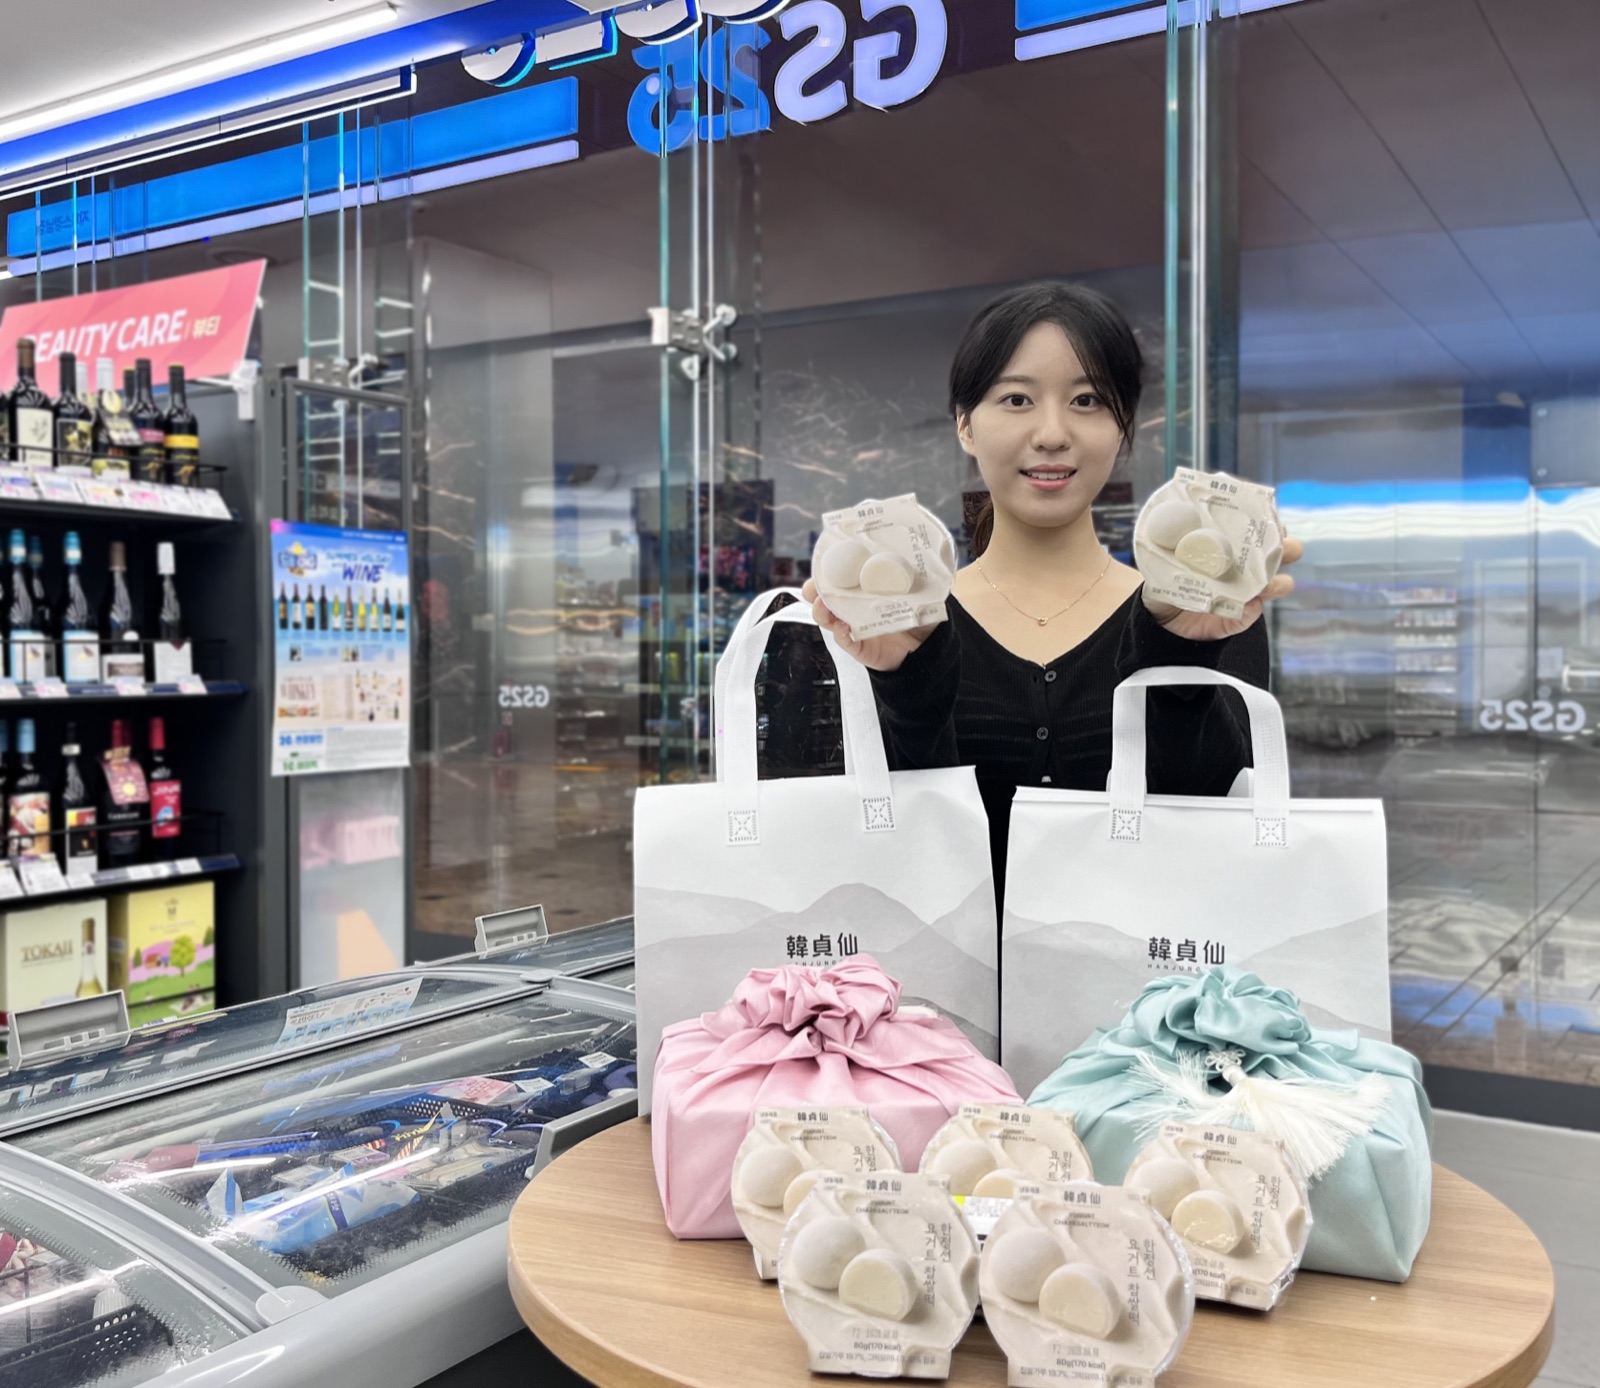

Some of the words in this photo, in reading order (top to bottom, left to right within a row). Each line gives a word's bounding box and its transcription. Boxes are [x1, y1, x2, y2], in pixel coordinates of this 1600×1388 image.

[23, 321, 118, 364] EAUTY
[117, 309, 187, 350] CARE
[193, 315, 221, 338] 뷰티
[343, 563, 385, 583] WINE
[786, 932, 858, 959] 韓貞仙
[1148, 936, 1225, 965] 韓貞仙
[924, 1224, 938, 1261] 요거트
[1127, 1240, 1140, 1278] 요거트
[1192, 1269, 1208, 1279] (170
